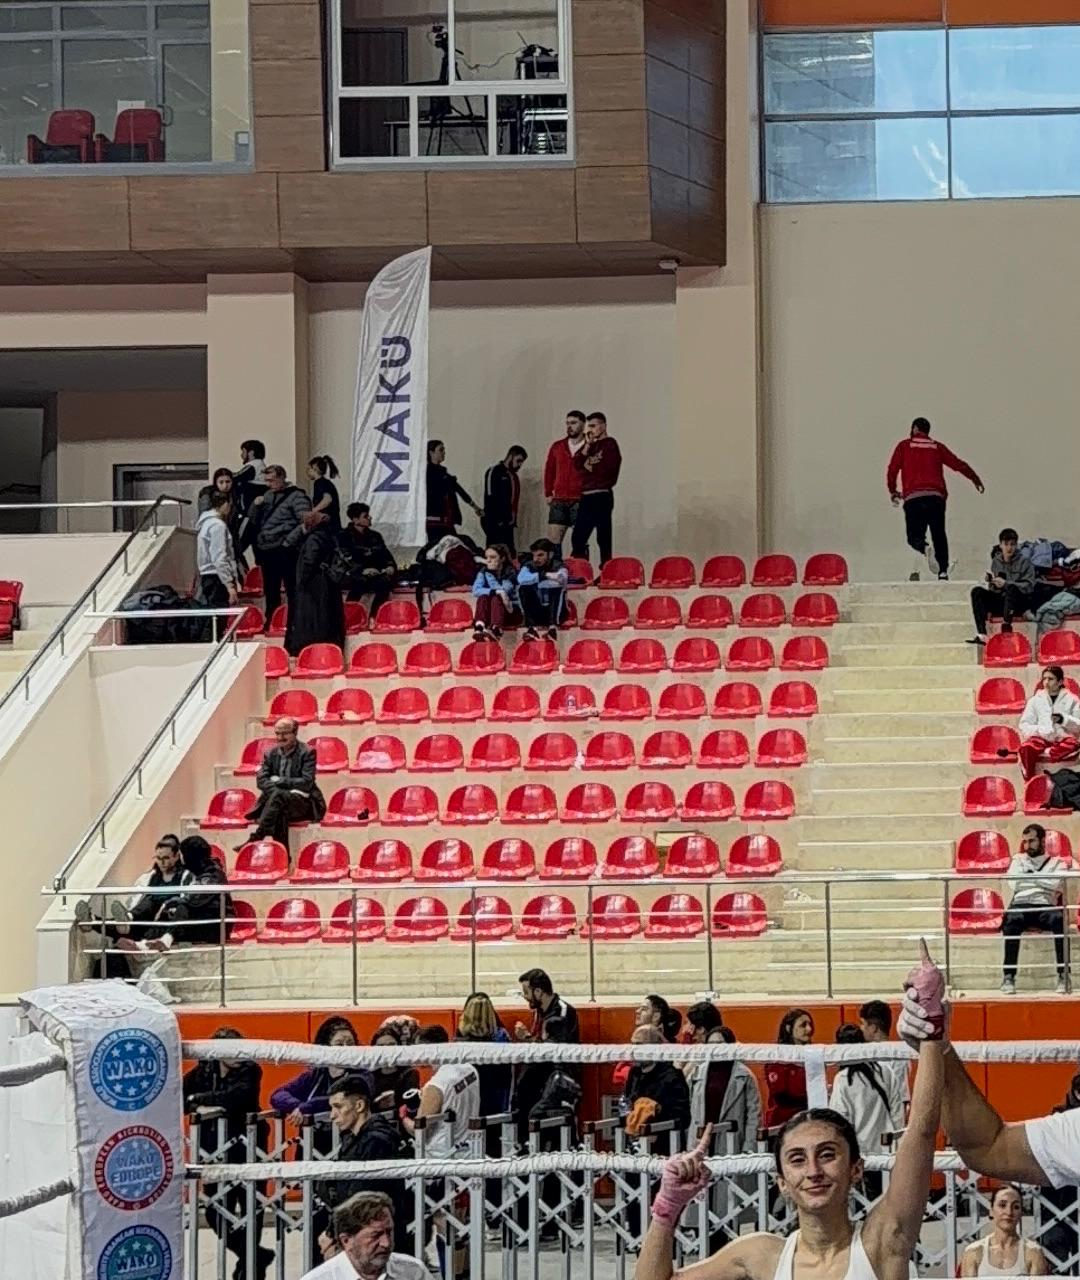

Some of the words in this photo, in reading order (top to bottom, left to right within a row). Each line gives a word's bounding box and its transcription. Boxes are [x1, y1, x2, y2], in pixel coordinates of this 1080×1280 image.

[373, 335, 412, 493] MAKÜ
[103, 1057, 157, 1080] WAKO
[115, 1253, 157, 1274] WAKO
